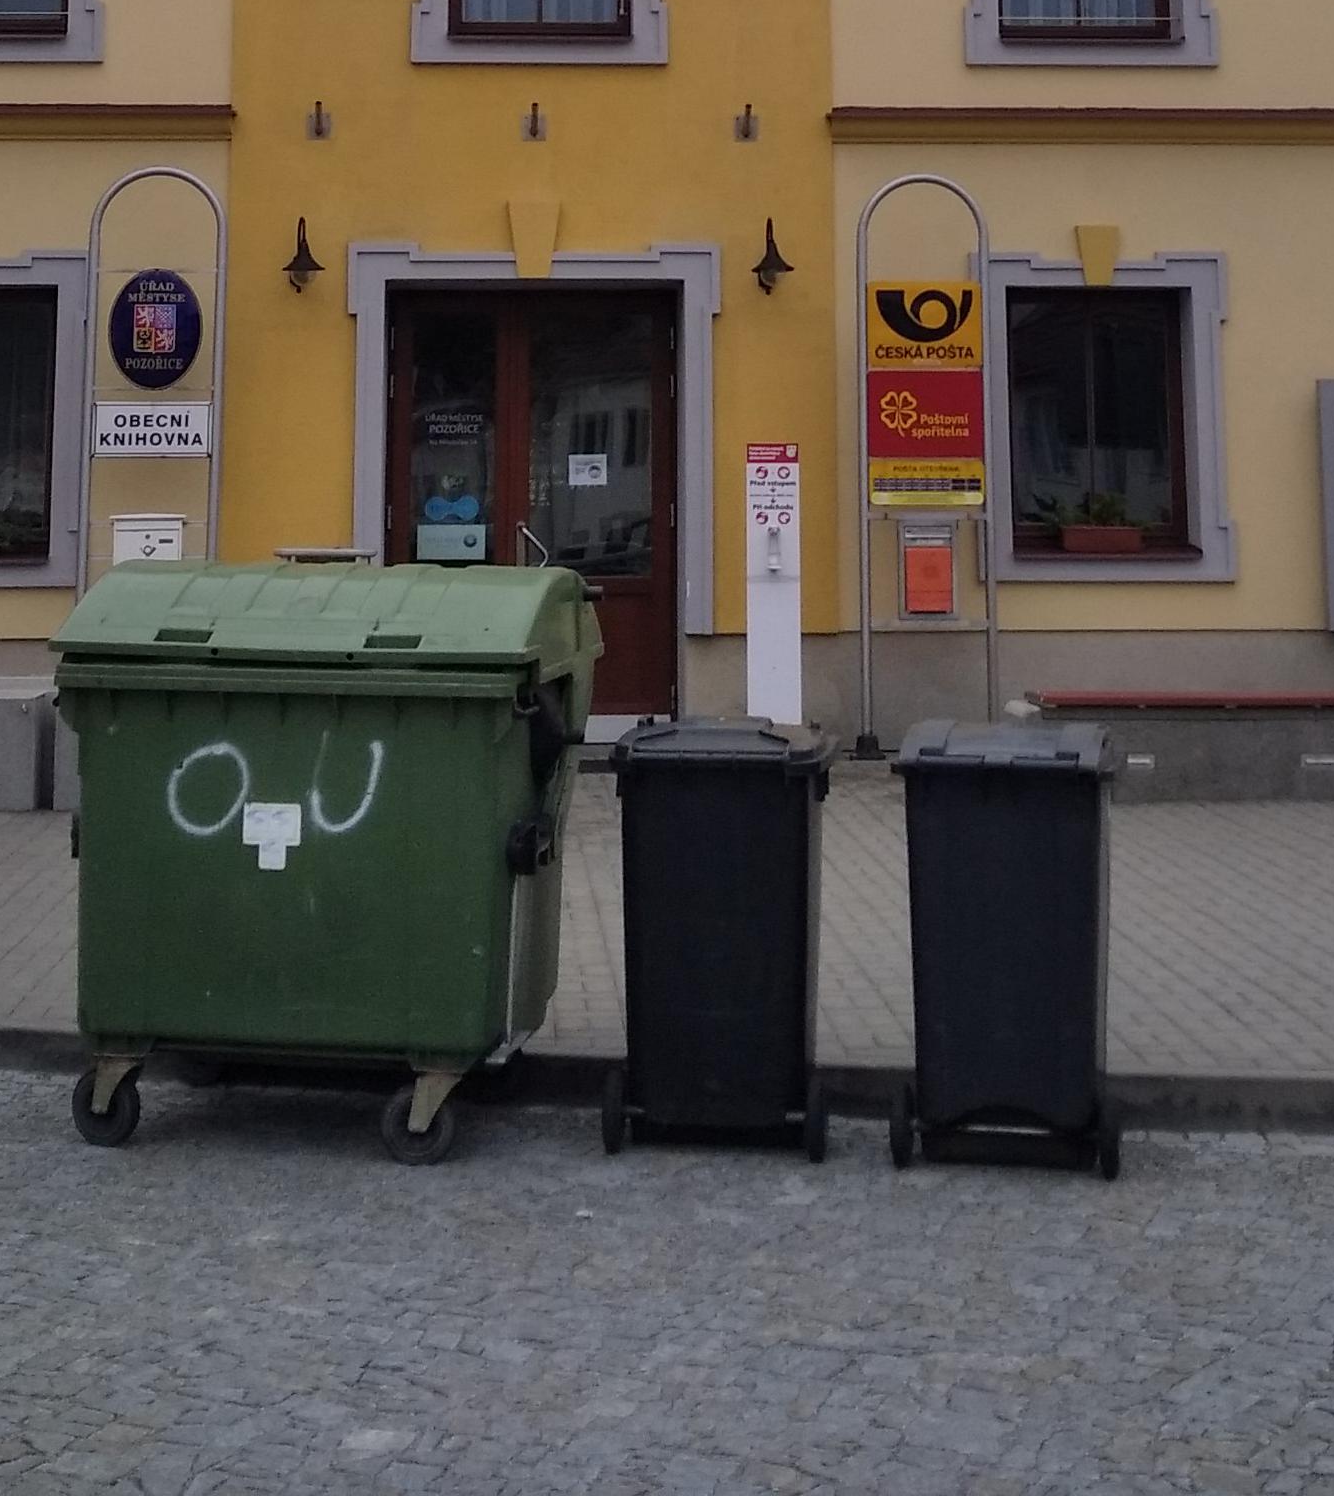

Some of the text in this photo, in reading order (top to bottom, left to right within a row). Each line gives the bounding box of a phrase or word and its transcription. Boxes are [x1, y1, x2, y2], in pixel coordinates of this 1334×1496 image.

[139, 279, 175, 292] ÚŘAD
[127, 291, 187, 303] MĚSTYSE
[874, 344, 975, 359] ČESKÁ POŠTA
[124, 356, 184, 370] POZOŘICE
[113, 410, 190, 428] OBECNÍ
[919, 413, 970, 425] Poštovní
[428, 423, 481, 434] POZOŘICE
[911, 426, 970, 440] spořitelna
[99, 433, 203, 446] KNIHOVNA
